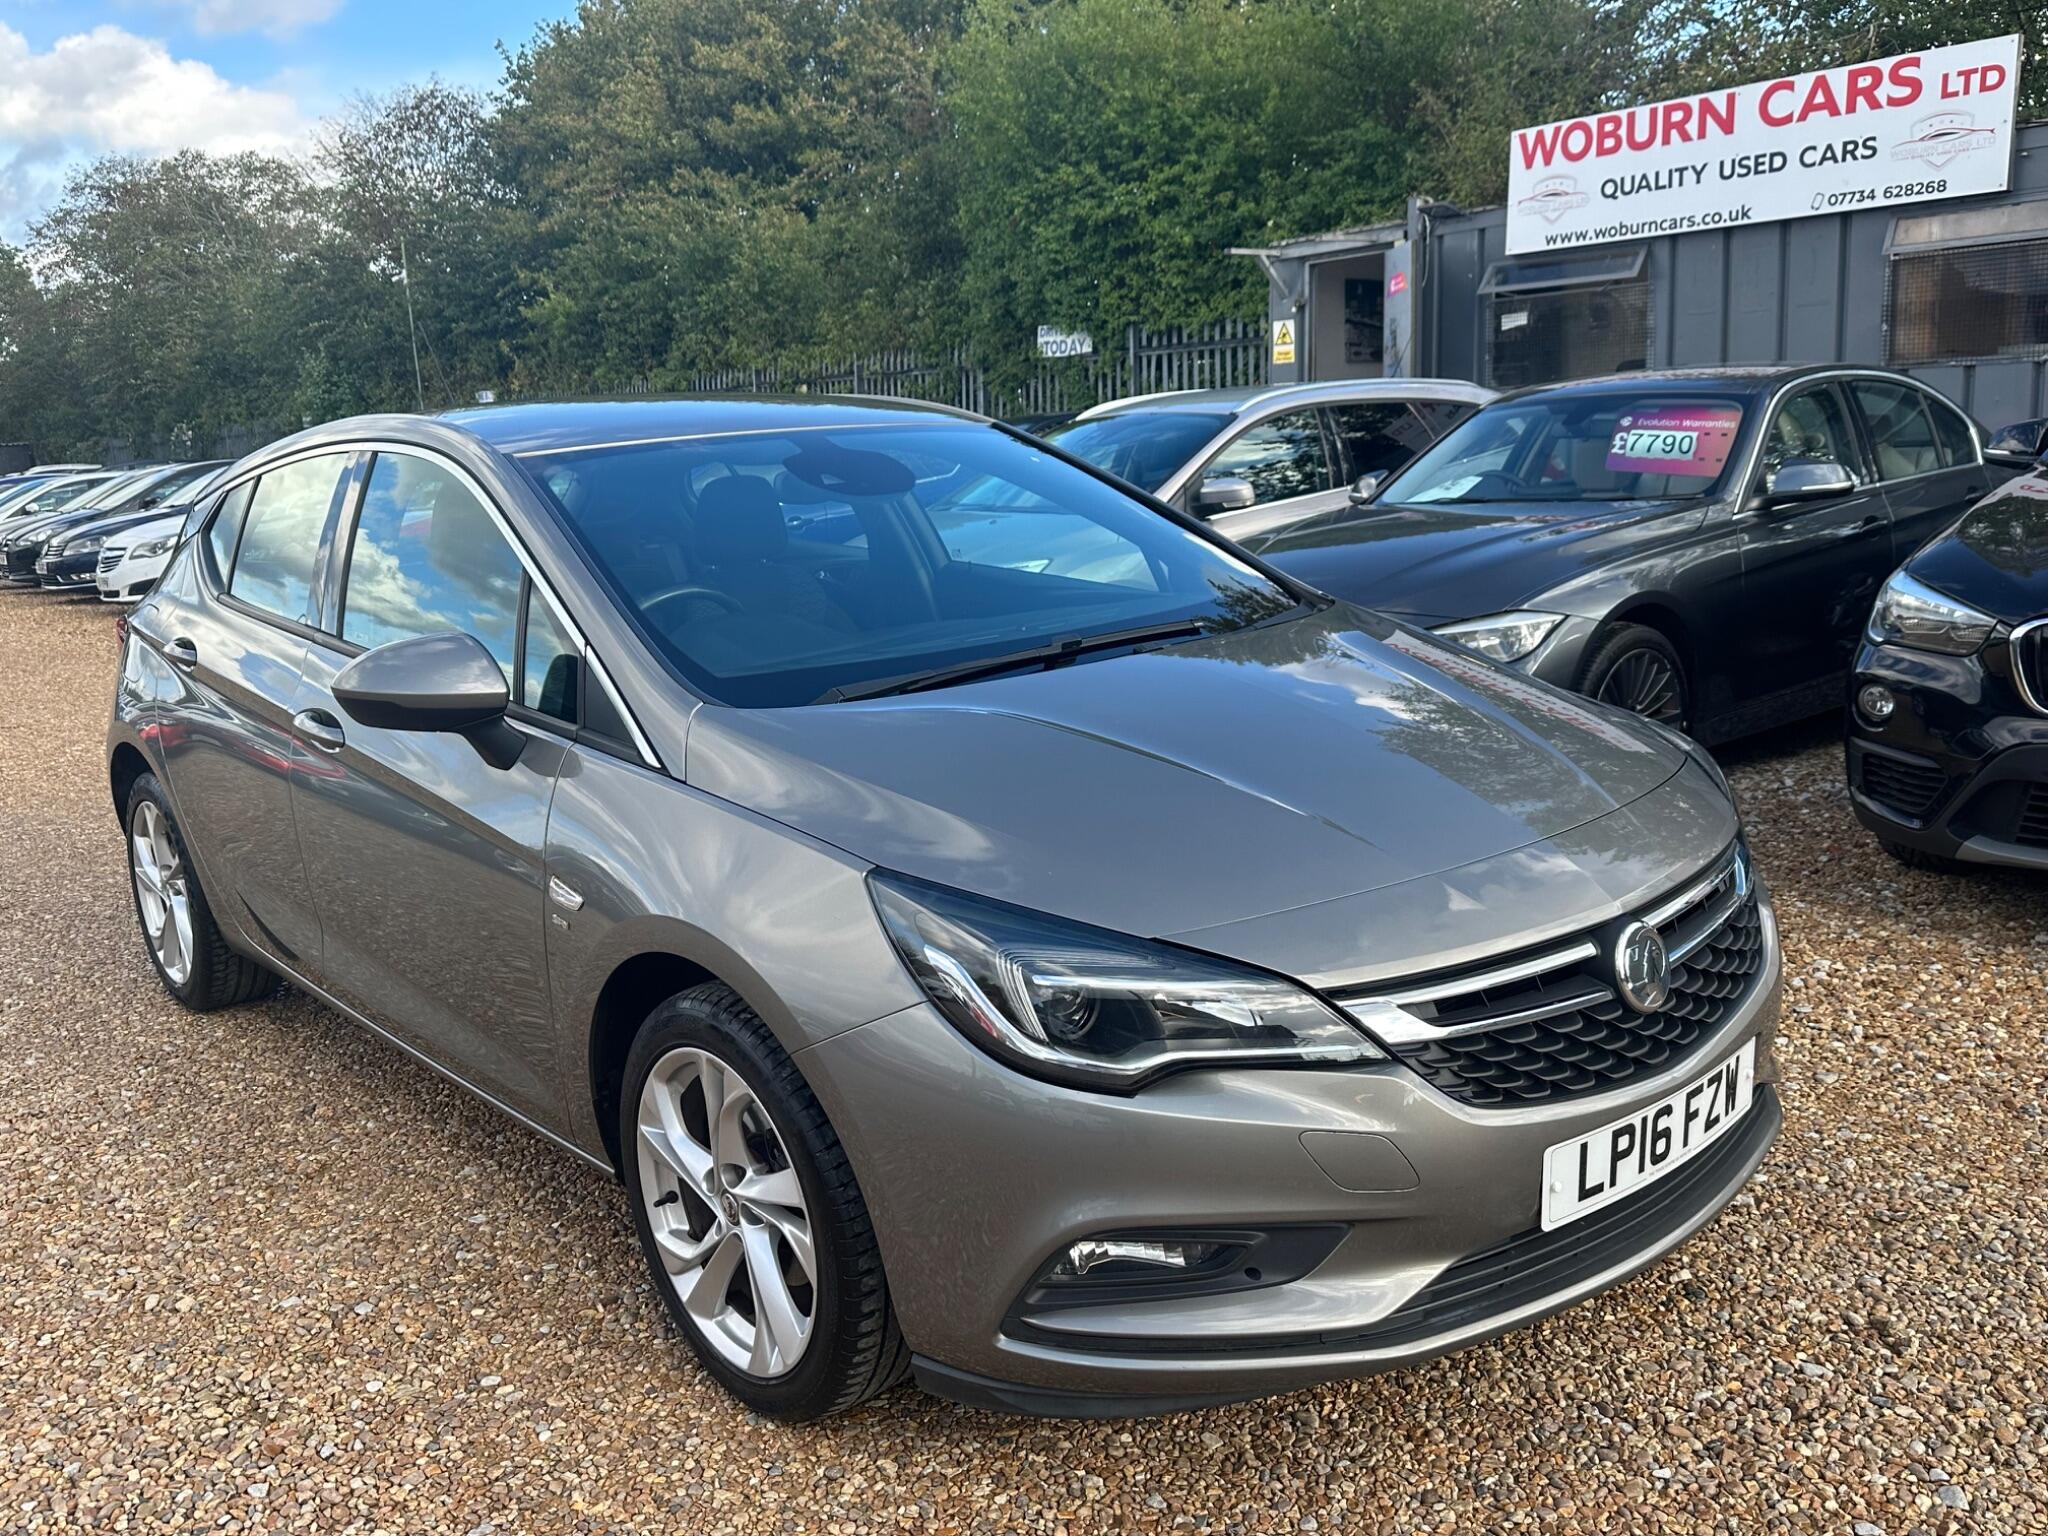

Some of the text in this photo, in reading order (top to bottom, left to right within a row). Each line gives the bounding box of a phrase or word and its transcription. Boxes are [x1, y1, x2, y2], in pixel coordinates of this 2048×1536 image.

[1518, 56, 2006, 170] WOBURN CARS LTD
[1600, 136, 1878, 200] QUALITY USED CARS
[1827, 179, 1948, 206] 07734 628268
[1545, 204, 1752, 247] www.woburncars.co.uk
[1043, 336, 1088, 355] TODAY
[1638, 419, 1736, 428] Evolution Warranties
[1611, 432, 1694, 454] £7790
[1577, 1054, 1740, 1203] LP16 FZW
